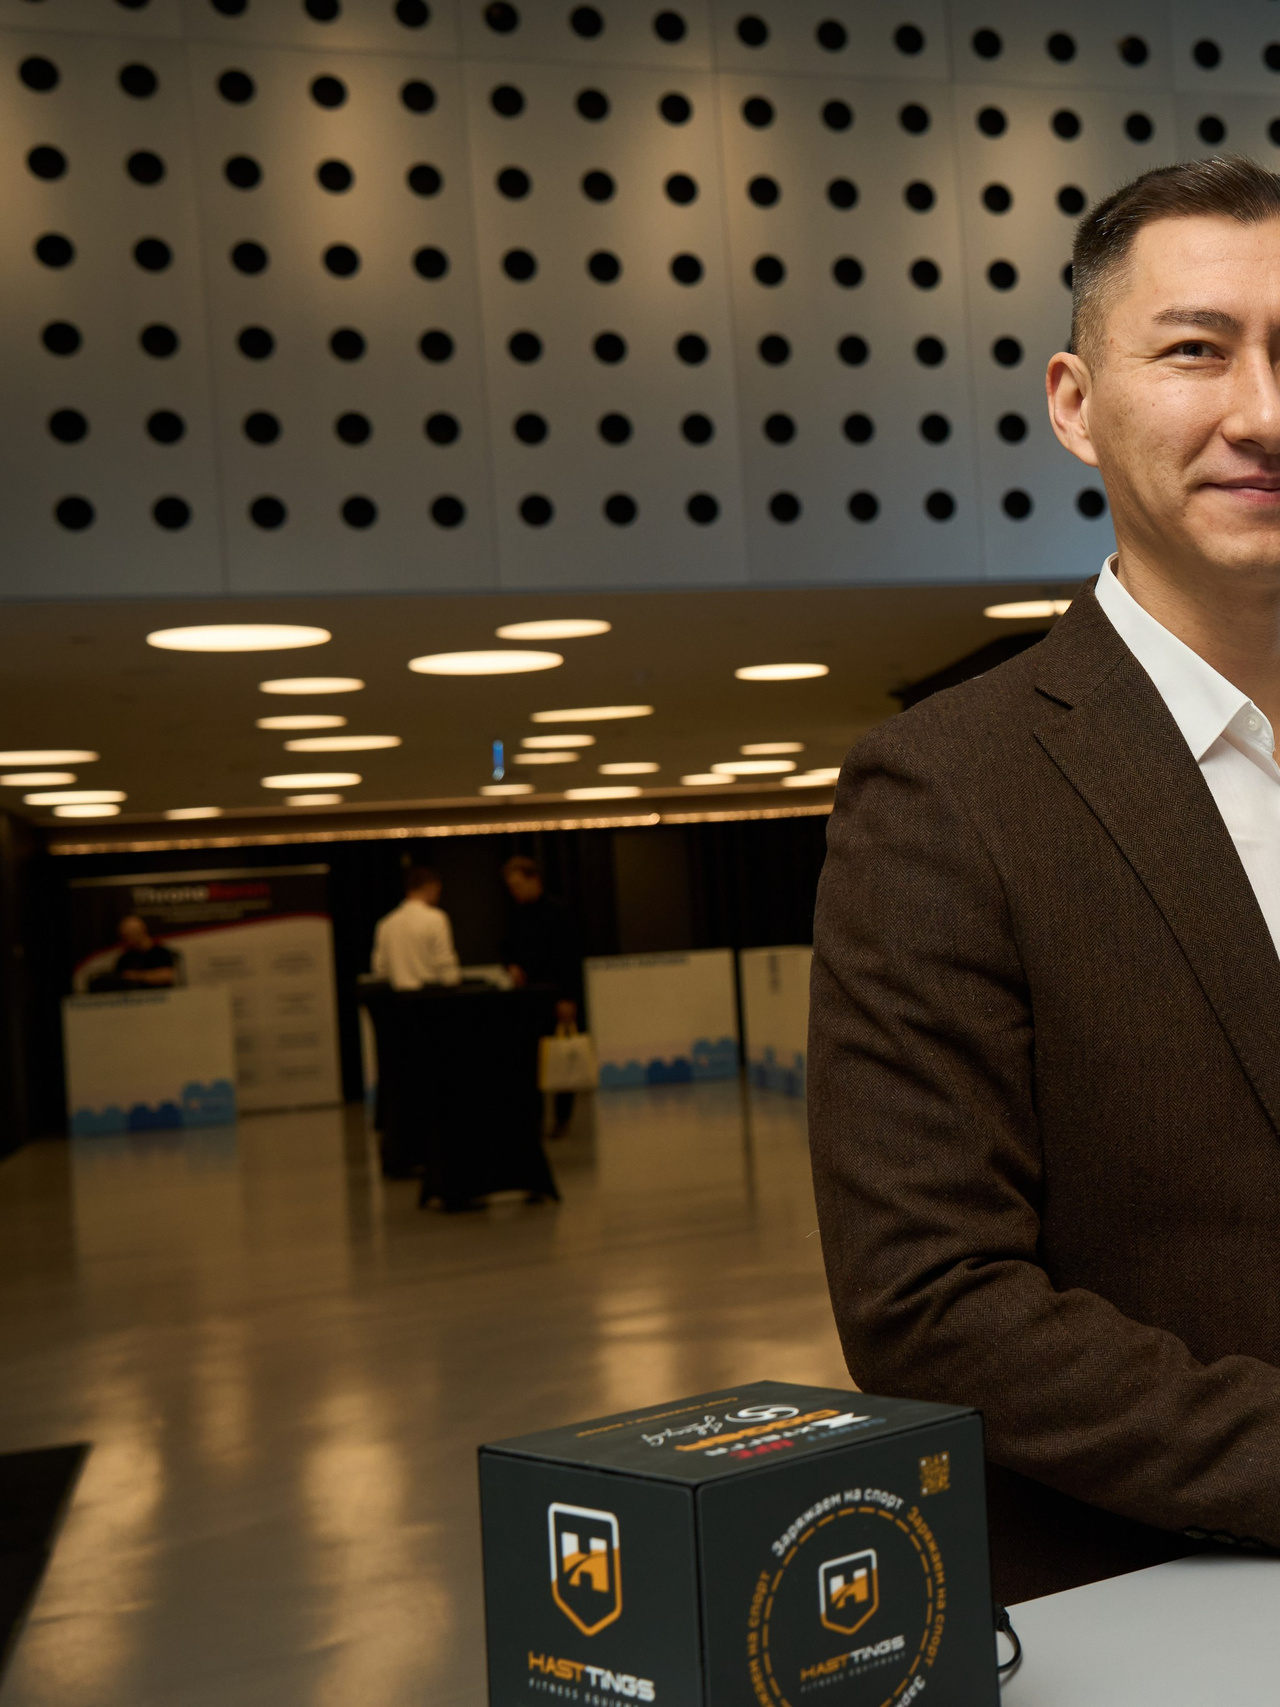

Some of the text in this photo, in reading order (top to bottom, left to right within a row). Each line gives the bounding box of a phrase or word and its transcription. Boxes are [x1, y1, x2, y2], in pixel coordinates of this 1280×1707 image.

[772, 1488, 904, 1557] Заряжаем на спорт
[528, 1651, 655, 1702] HASTTINGS
[800, 1634, 905, 1682] HASTTINGS
